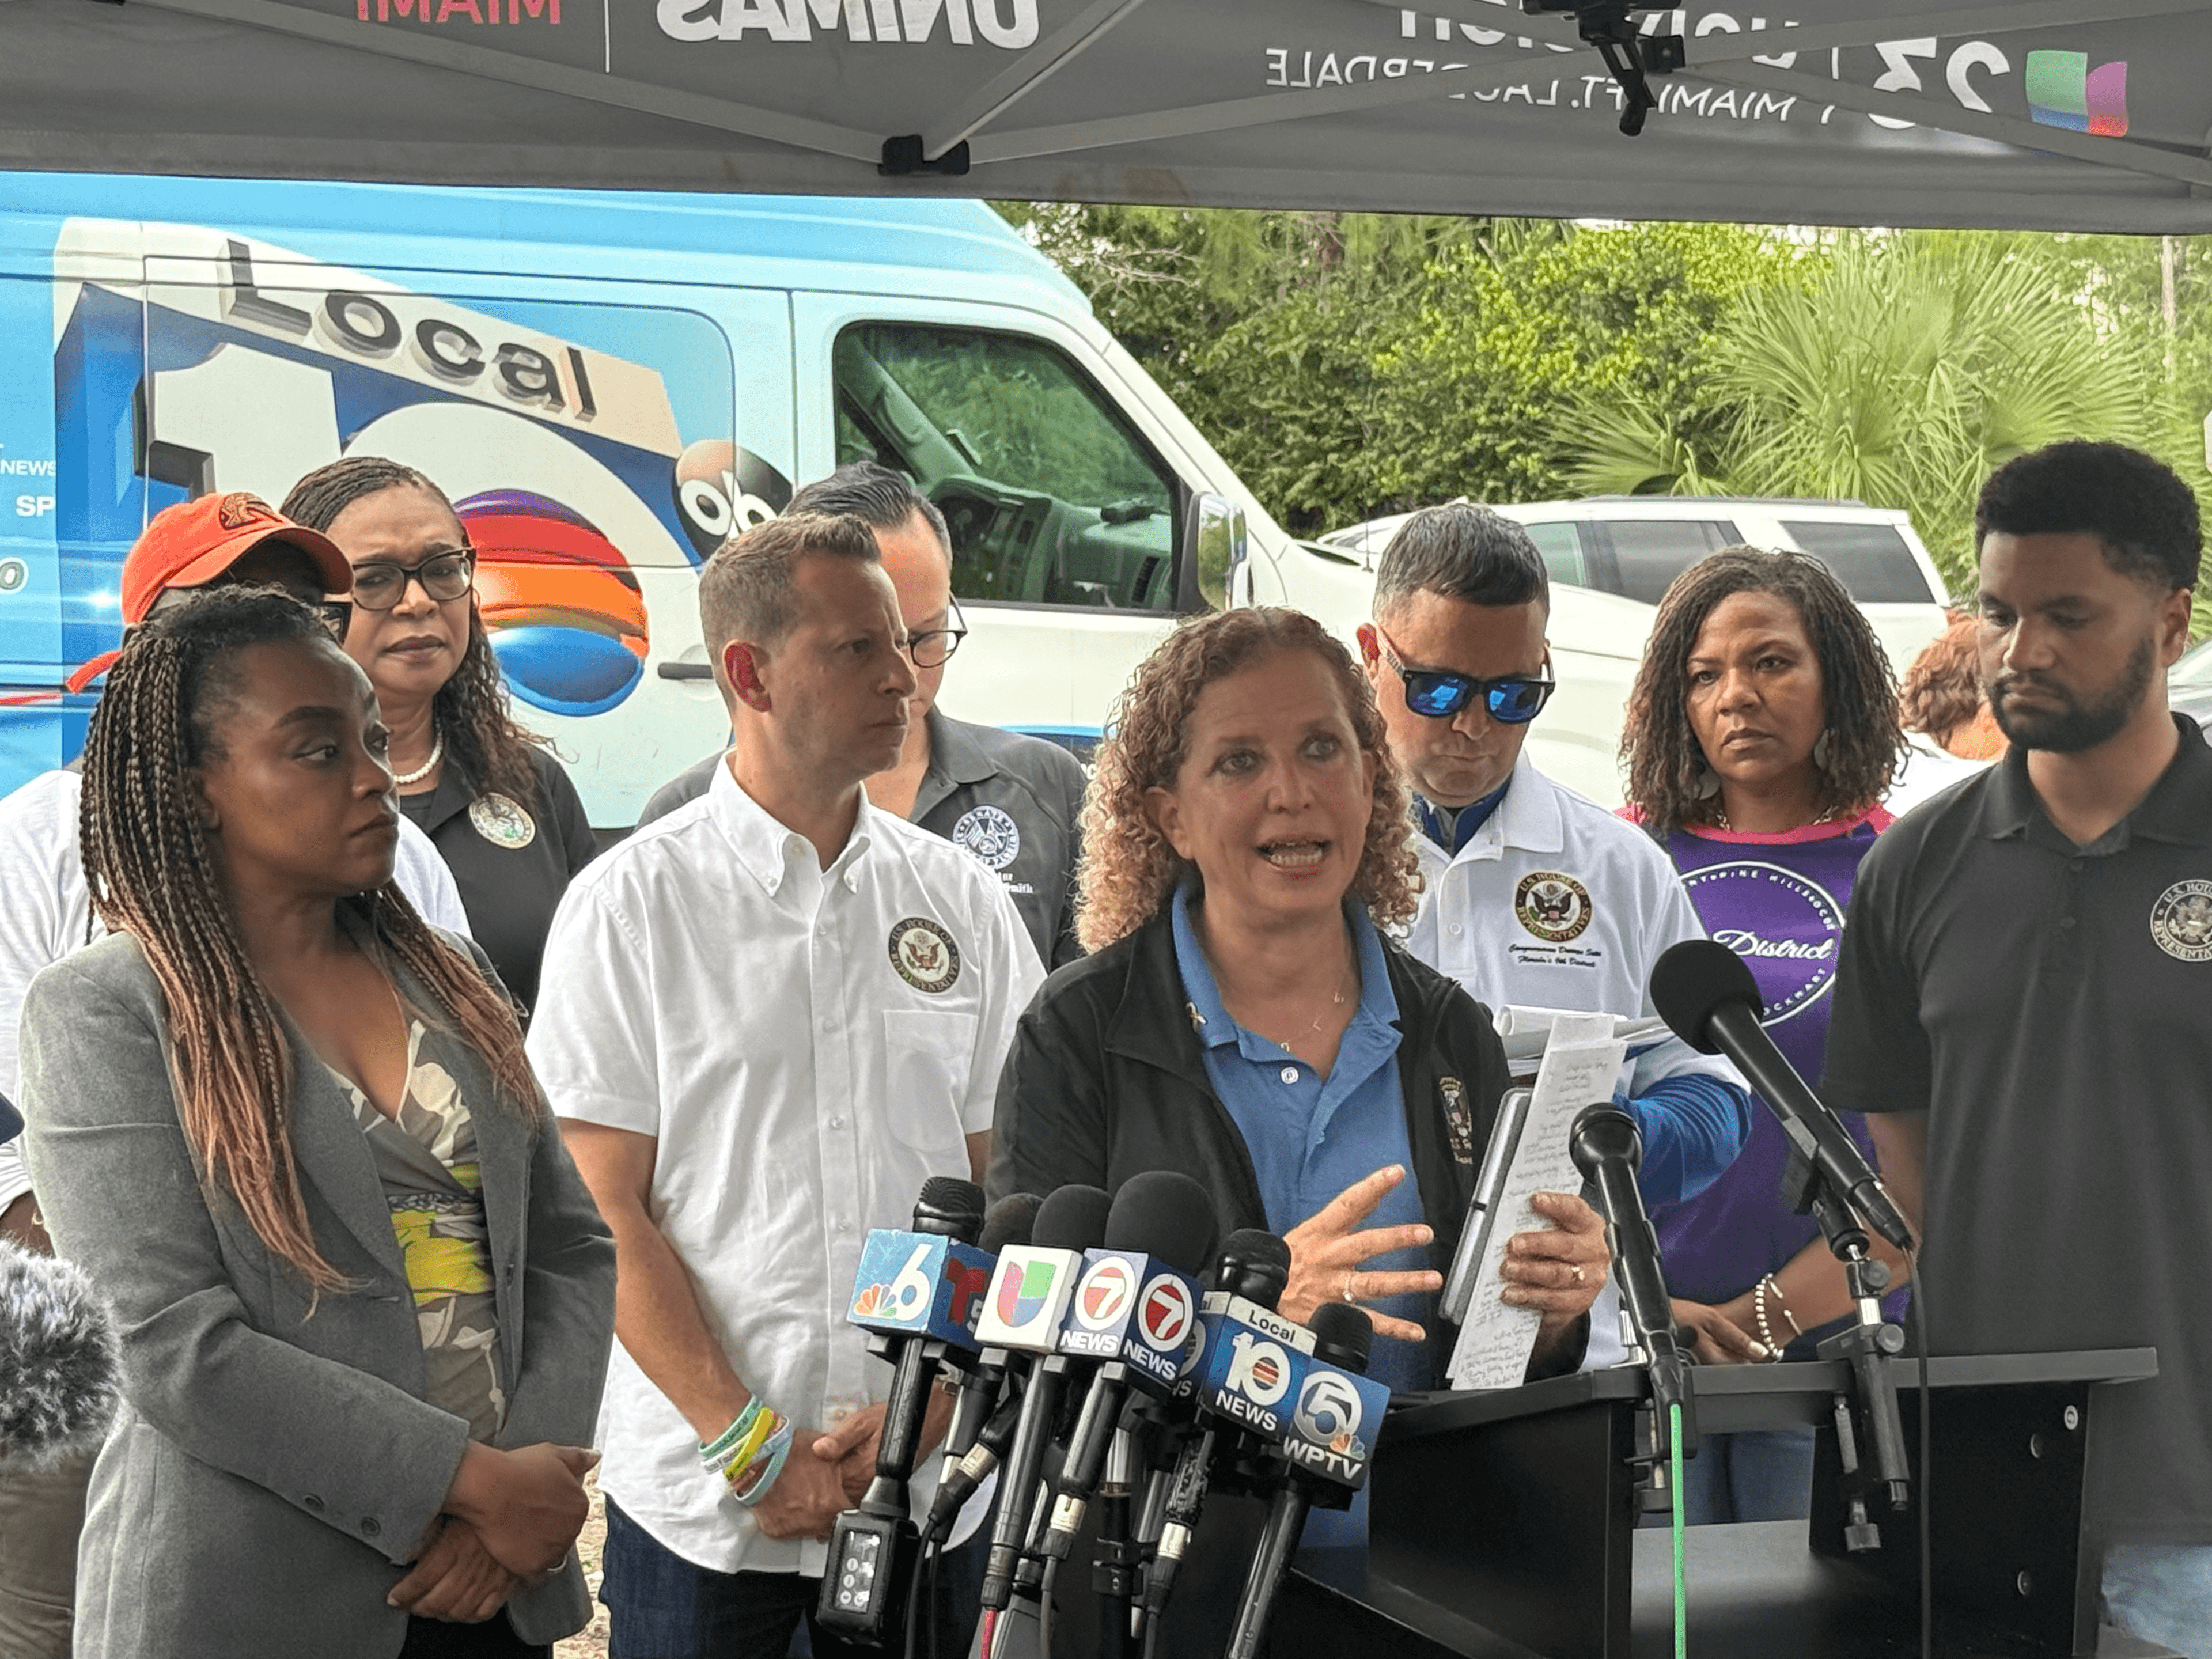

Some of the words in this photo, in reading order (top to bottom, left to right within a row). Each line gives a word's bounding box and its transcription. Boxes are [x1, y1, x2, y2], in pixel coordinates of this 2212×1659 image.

[221, 236, 598, 423] Local
[1712, 929, 1836, 959] District
[891, 1243, 933, 1321] 6
[1088, 1275, 1125, 1320] 7
[1151, 1289, 1184, 1339] 7
[1248, 1309, 1296, 1343] Local
[1059, 1330, 1119, 1353] NEWS
[1123, 1338, 1177, 1381] NEWS
[1224, 1331, 1291, 1406] 10
[1215, 1389, 1278, 1431] NEWS
[1300, 1377, 1355, 1441] 5
[1283, 1435, 1363, 1480] WPTV
